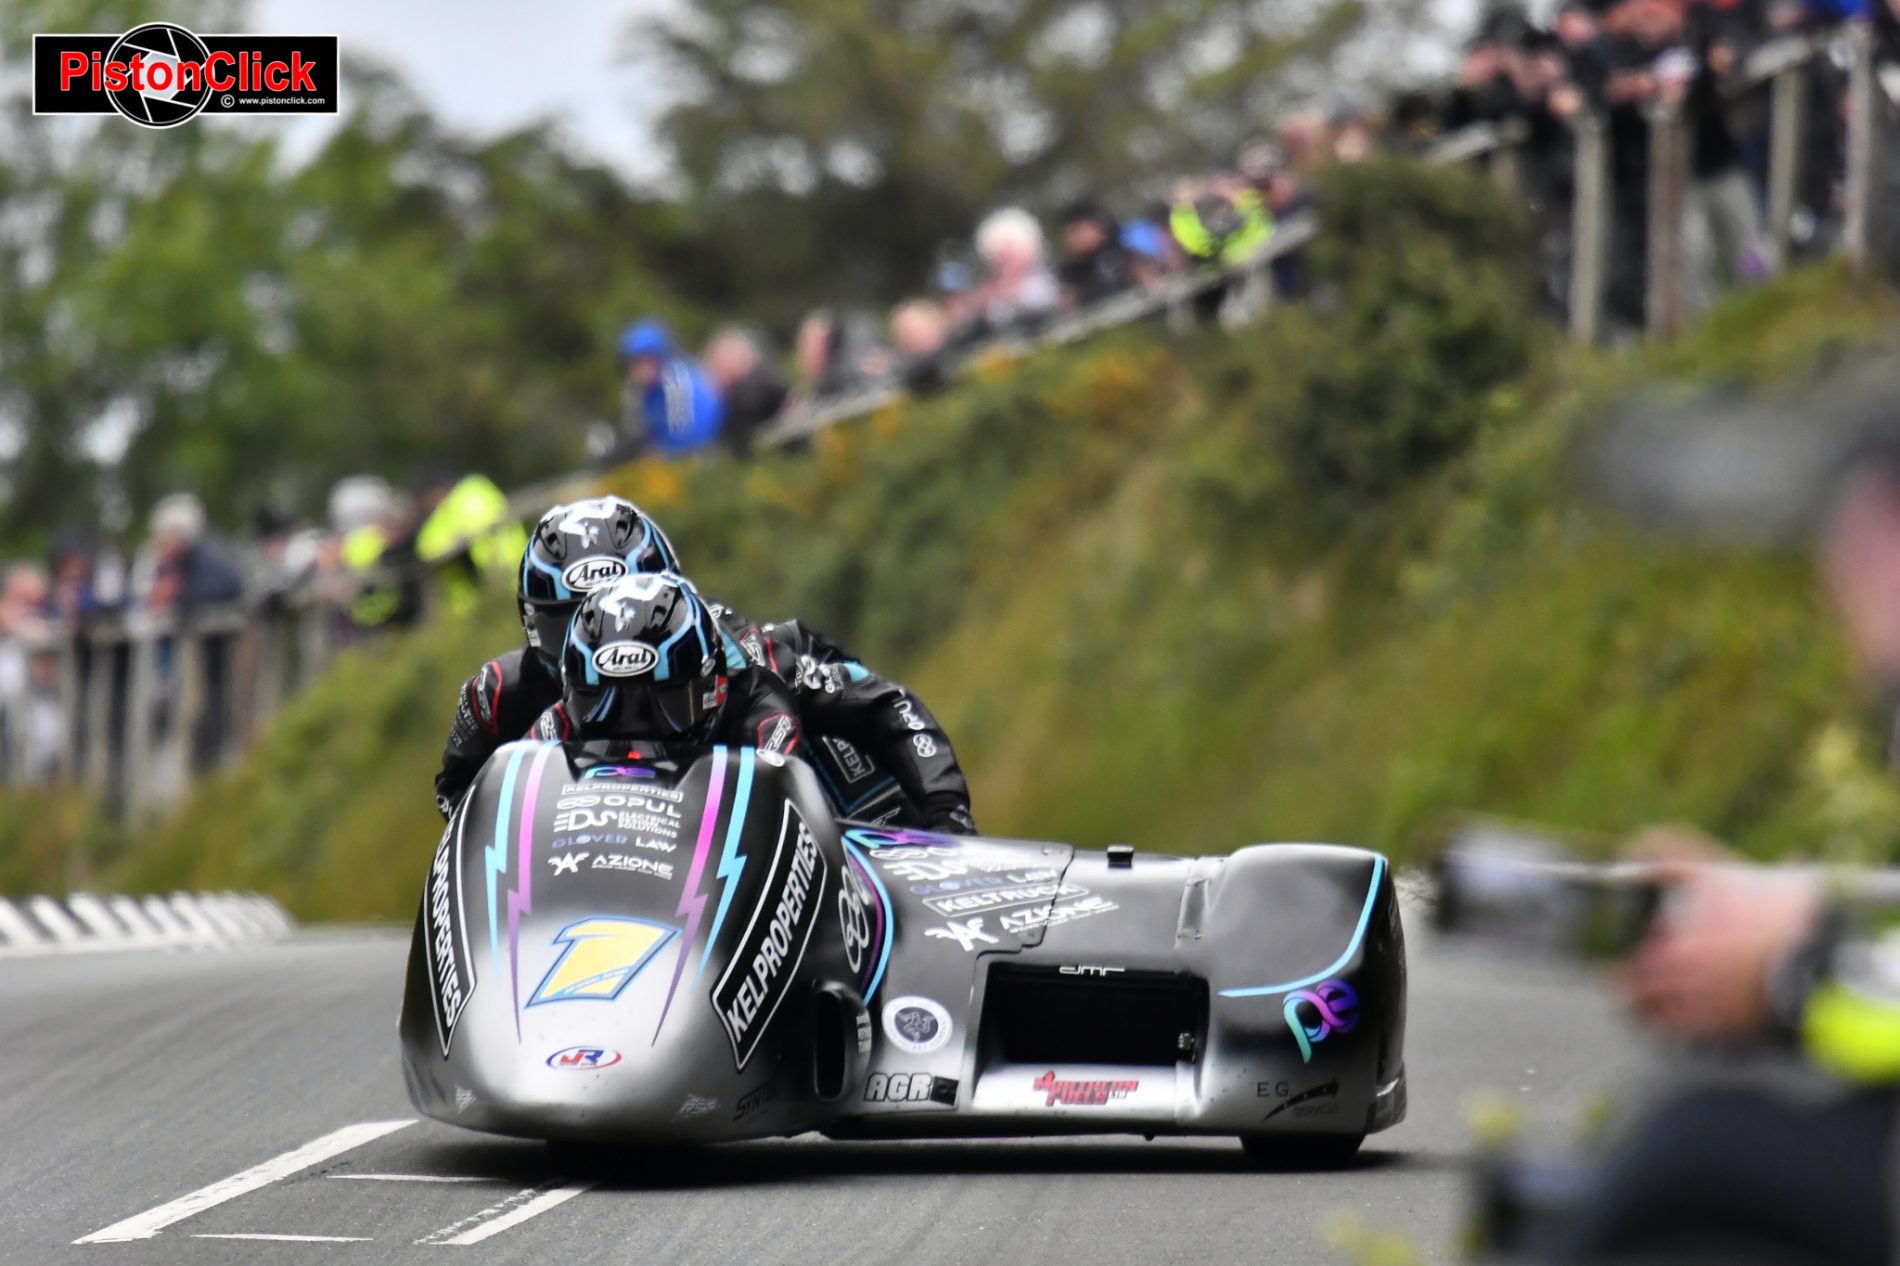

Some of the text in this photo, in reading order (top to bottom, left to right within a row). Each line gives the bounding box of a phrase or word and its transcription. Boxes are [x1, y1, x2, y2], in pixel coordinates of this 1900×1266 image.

[571, 565, 619, 584] Arai
[600, 646, 648, 667] Arai
[603, 795, 682, 818] OPUL
[552, 834, 677, 852] GLOVER LAW
[592, 854, 674, 875] AZIONE
[936, 884, 1079, 912] KELTRUCK
[432, 816, 462, 1029] LPROPERTIES
[727, 822, 817, 1042] KELPROPERTIES
[864, 1072, 933, 1102] AGR
